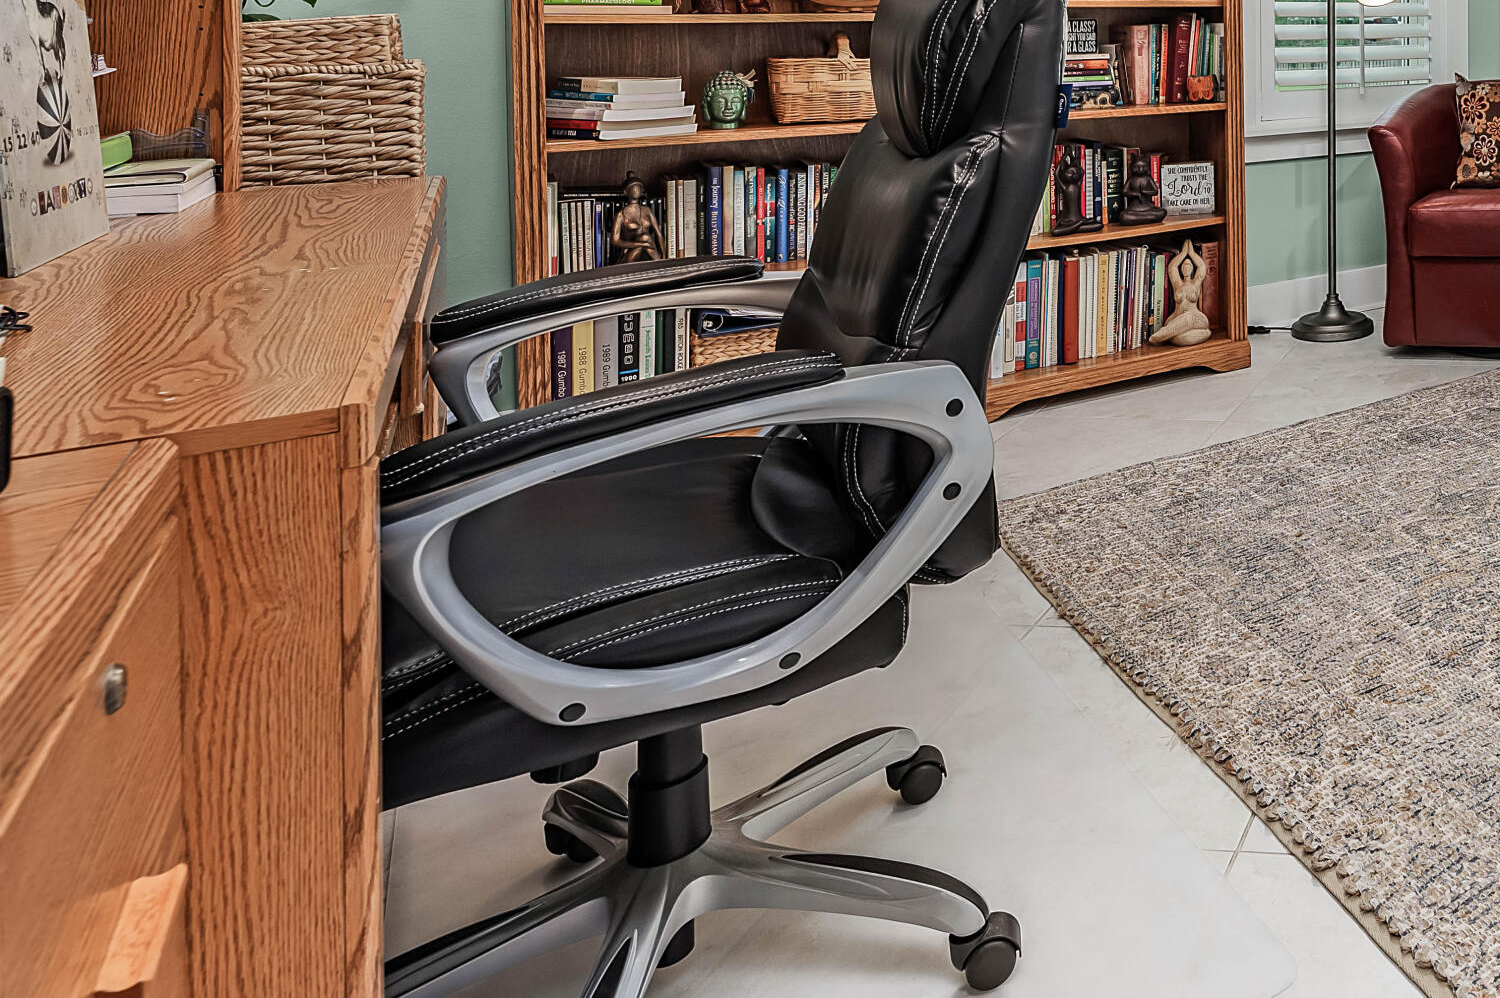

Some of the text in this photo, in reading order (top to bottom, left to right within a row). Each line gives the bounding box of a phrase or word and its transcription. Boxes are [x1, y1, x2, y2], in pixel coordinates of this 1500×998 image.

[1072, 20, 1096, 32] CLASS?
[1078, 41, 1096, 52] GLASS
[3, 136, 13, 153] 15
[17, 133, 28, 150] 22
[1177, 165, 1208, 174] CONFIDENTLY
[1181, 174, 1197, 182] TRUSTS
[710, 185, 720, 208] Journey
[797, 172, 806, 221] KNOWING GOD
[1163, 178, 1211, 197] Lord TO
[711, 228, 719, 256] GRAHAM
[578, 347, 587, 365] 1988
[602, 343, 611, 387] 1989 Gumb
[557, 350, 566, 398] 1987 Gumbo
